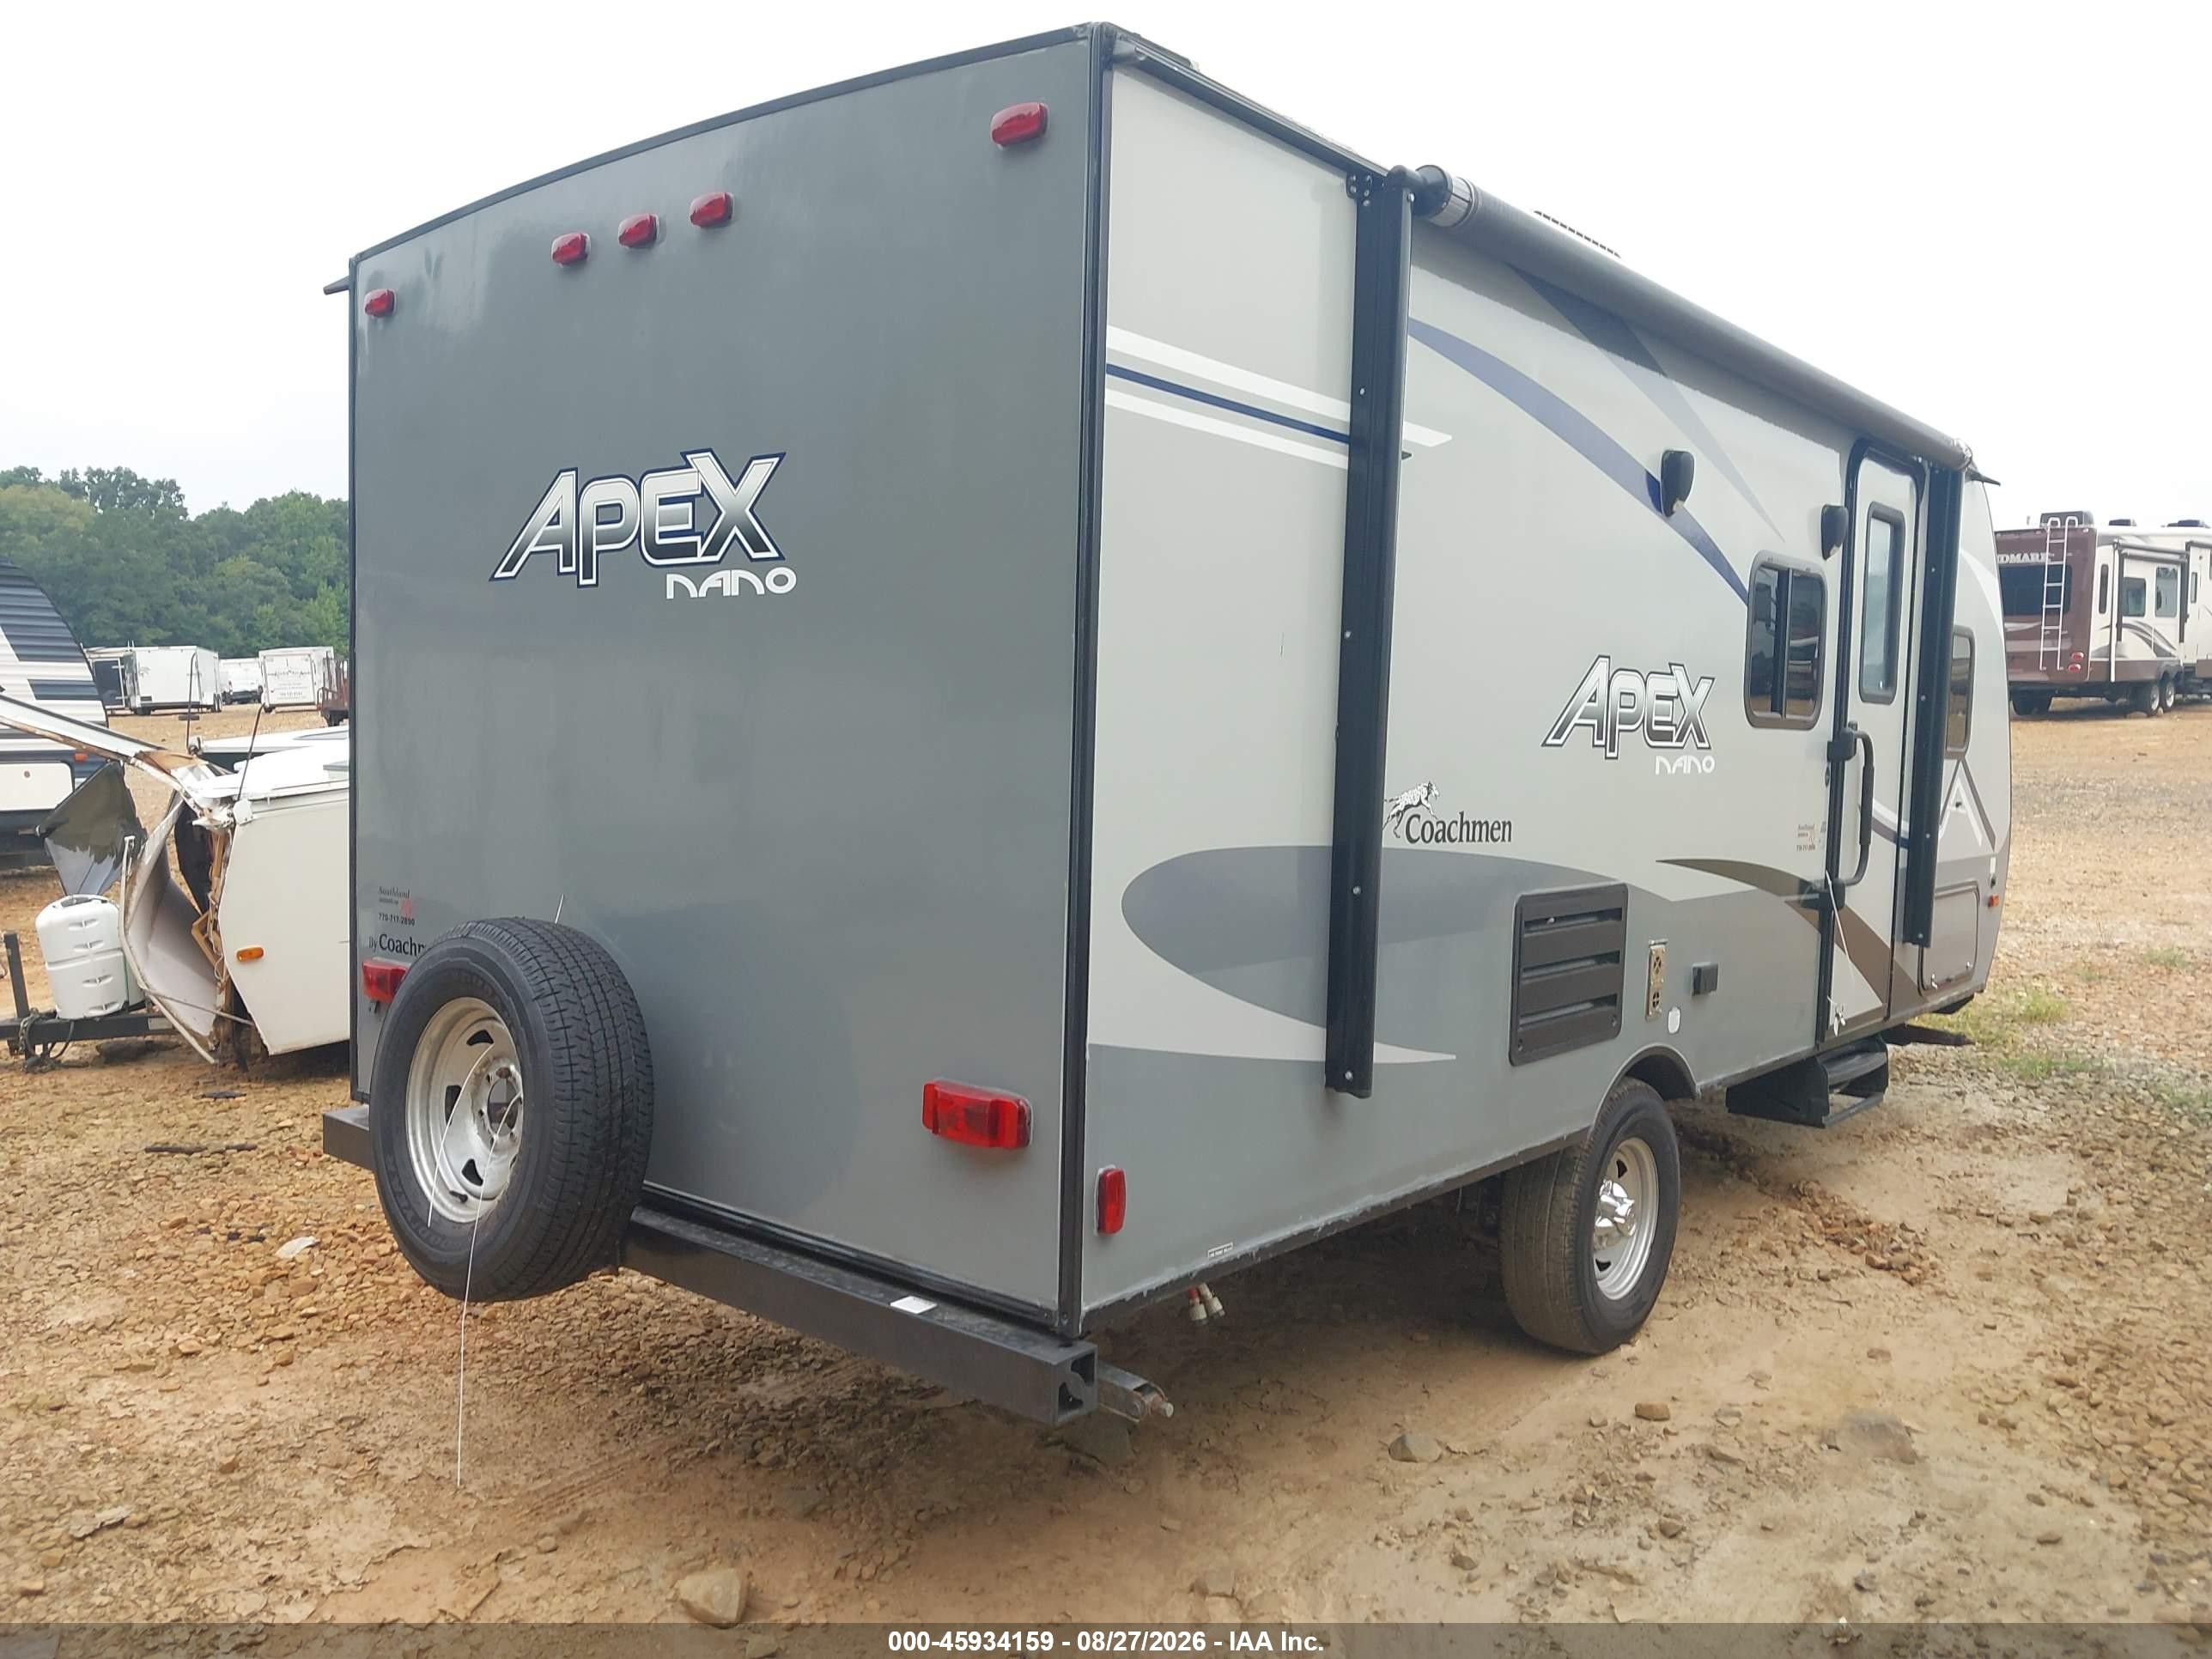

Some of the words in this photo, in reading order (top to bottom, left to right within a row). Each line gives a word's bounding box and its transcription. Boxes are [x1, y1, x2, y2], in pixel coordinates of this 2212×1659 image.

[489, 447, 786, 588] APEX
[1541, 654, 1716, 760] APEX
[1405, 811, 1512, 843] Coachmen
